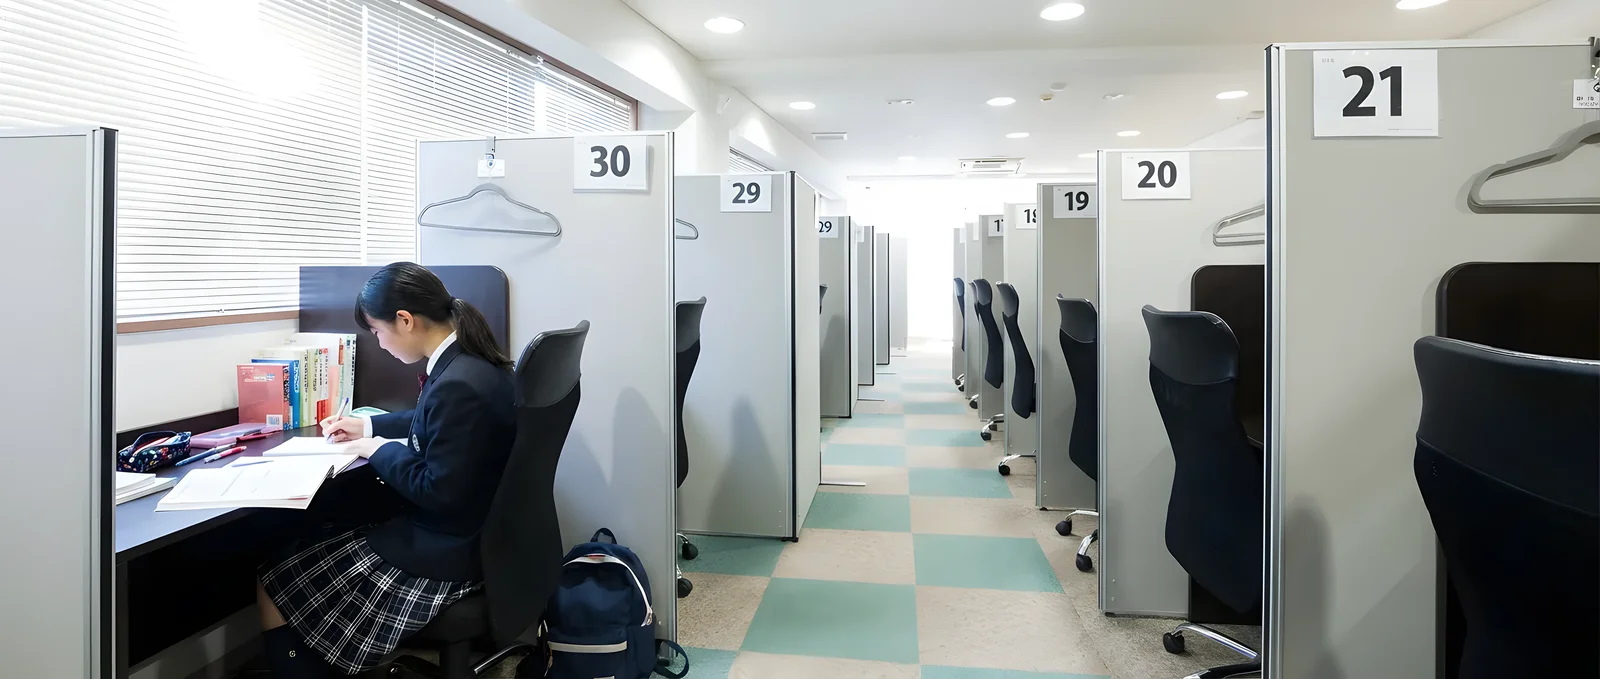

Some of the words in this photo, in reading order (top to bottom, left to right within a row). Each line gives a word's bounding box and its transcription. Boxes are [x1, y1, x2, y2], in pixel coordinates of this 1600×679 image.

[1342, 66, 1403, 117] 21
[590, 145, 630, 177] 30
[1138, 161, 1176, 188] 20
[732, 183, 761, 204] 29
[1064, 191, 1090, 211] 19
[818, 220, 832, 233] 29
[994, 219, 1004, 232] 1
